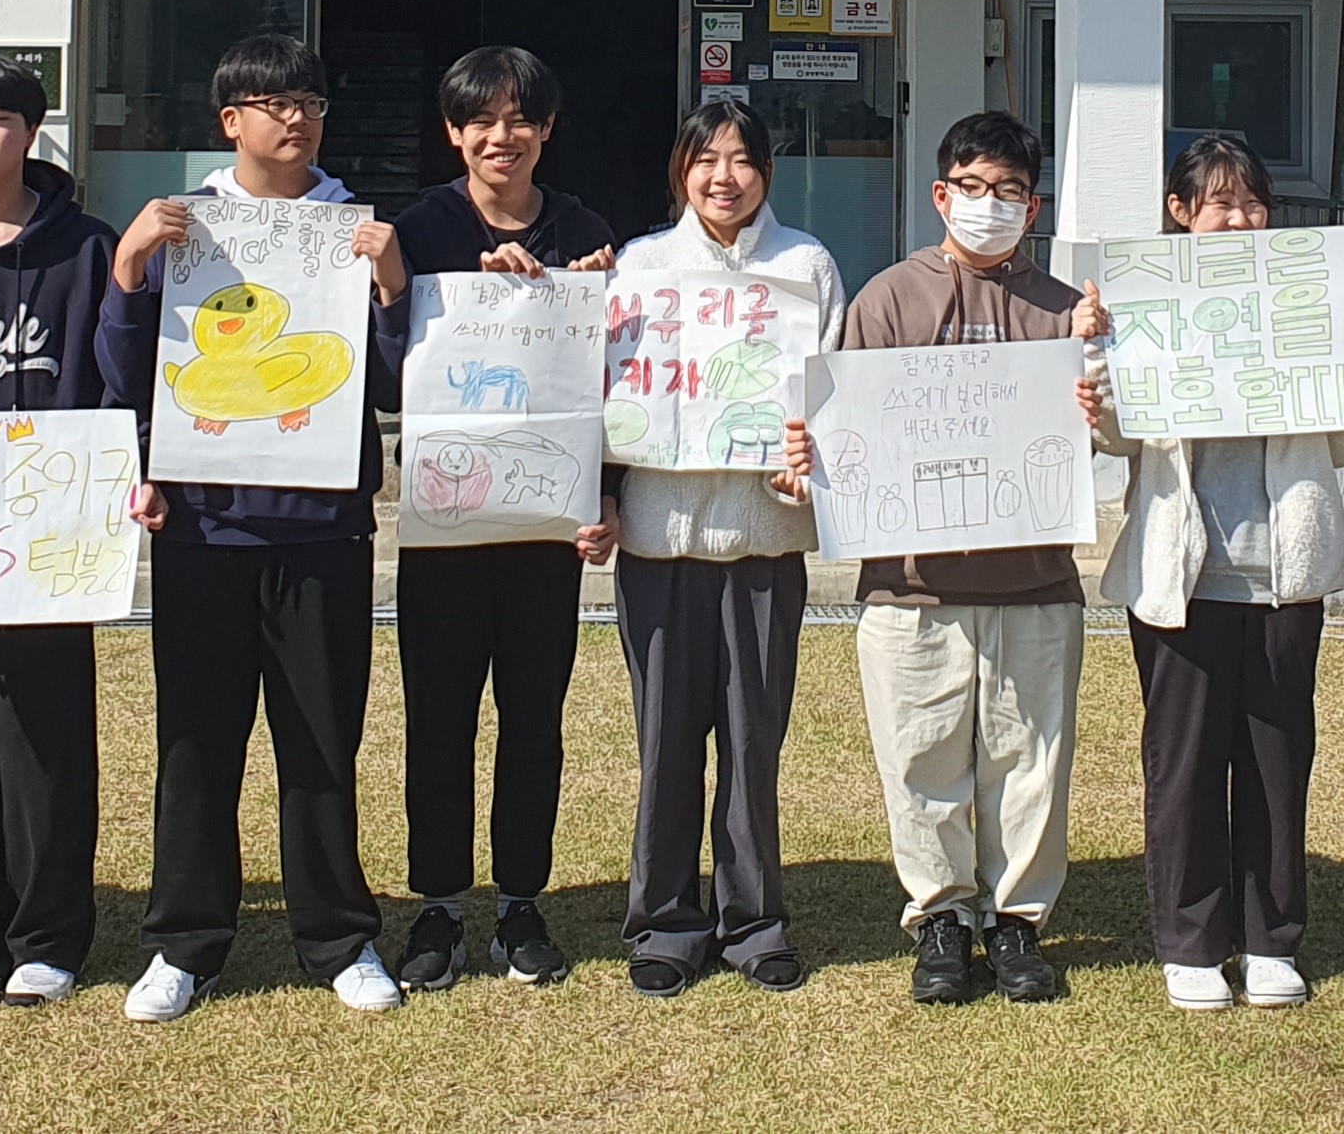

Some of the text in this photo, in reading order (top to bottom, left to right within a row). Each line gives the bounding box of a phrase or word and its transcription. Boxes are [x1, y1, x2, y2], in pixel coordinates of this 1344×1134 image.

[846, 1, 878, 17] 금연
[15, 53, 43, 63] 우리가
[1104, 228, 1329, 289] 지금은
[452, 322, 505, 342] 쓰레기
[1108, 282, 1332, 359] 자연을
[604, 356, 703, 402] 키자
[882, 381, 1018, 412] 쓰레기 분리해서
[1116, 355, 1223, 433] 보호
[28, 537, 134, 597] 텀블러
